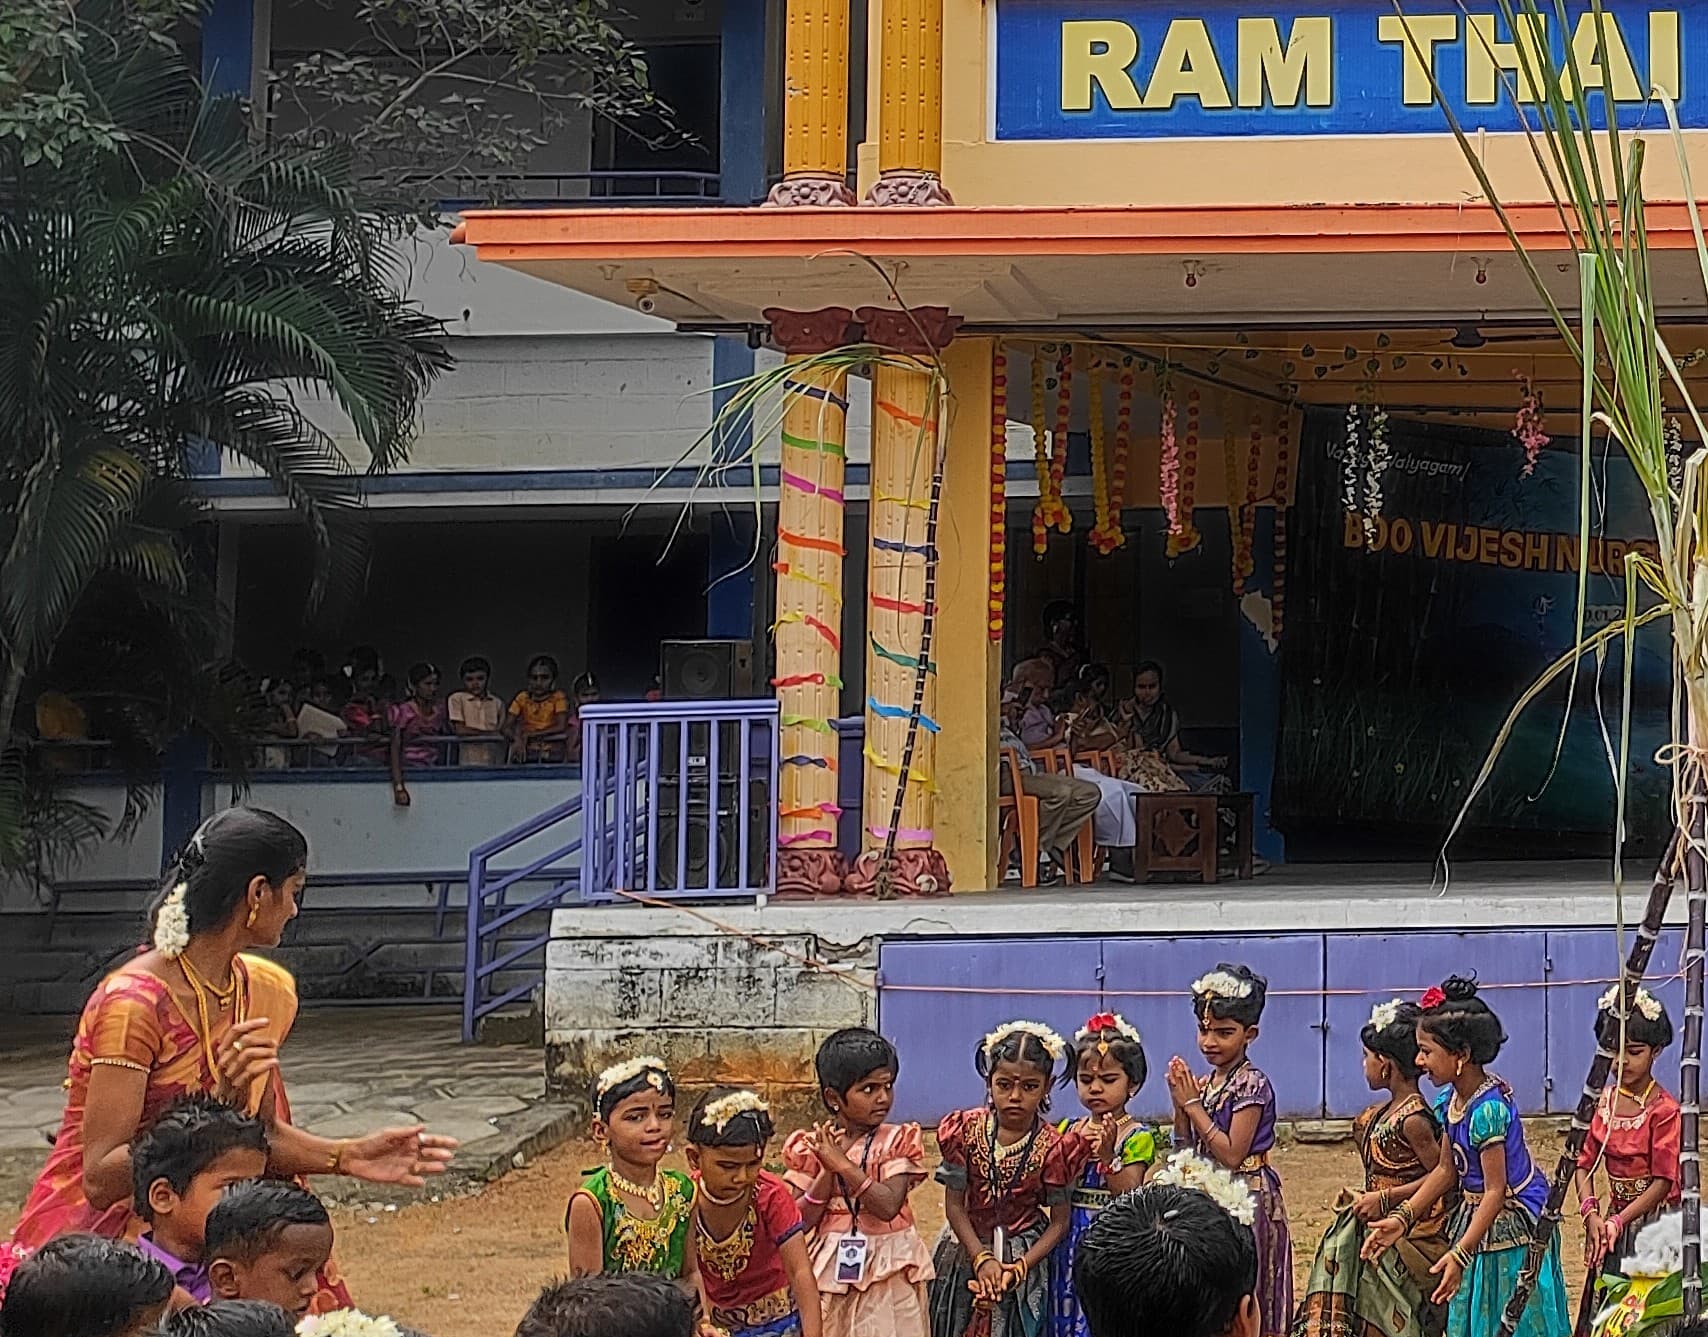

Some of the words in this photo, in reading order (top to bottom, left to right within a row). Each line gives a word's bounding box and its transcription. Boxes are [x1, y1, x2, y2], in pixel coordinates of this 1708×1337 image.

[1060, 16, 1334, 111] RAM
[1377, 8, 1682, 107] THAI
[1343, 511, 1413, 554] BOO
[1419, 519, 1551, 572] VIJESH
